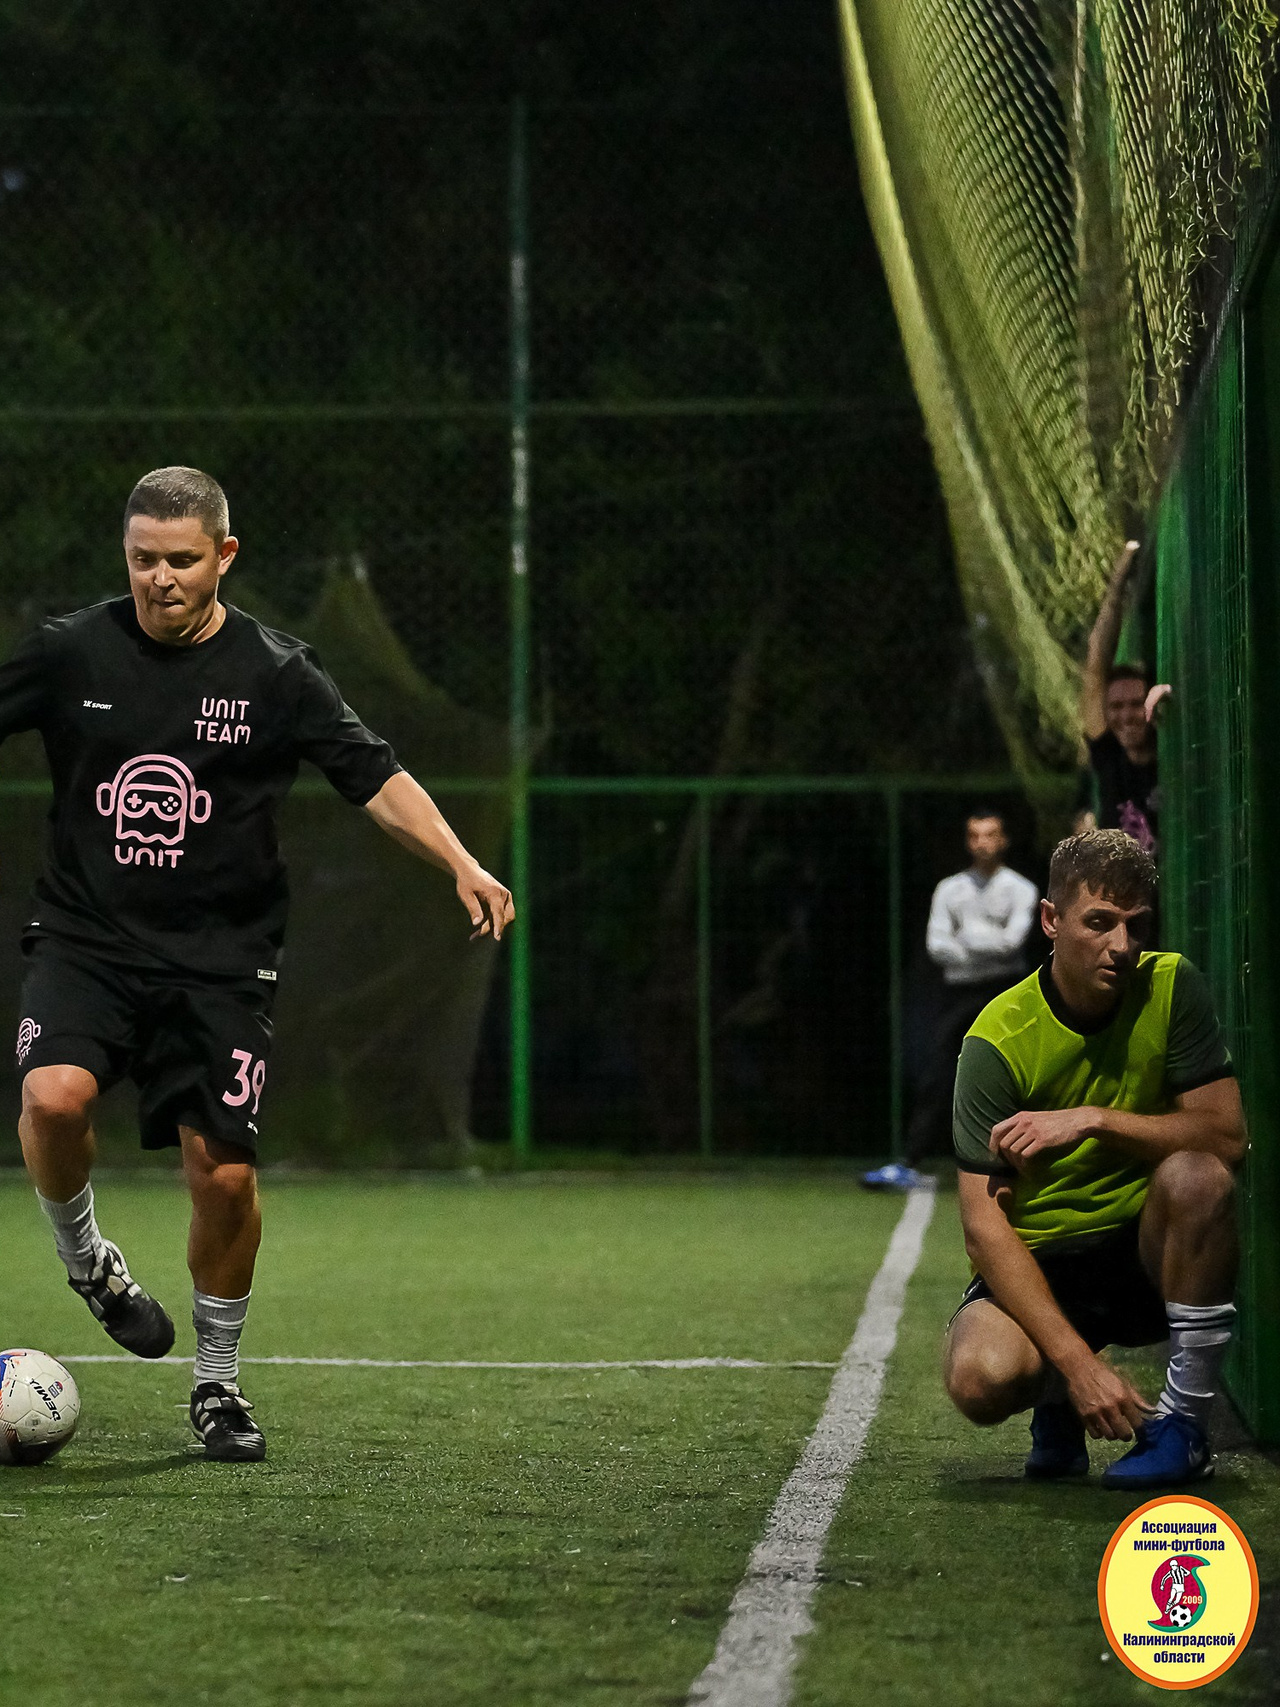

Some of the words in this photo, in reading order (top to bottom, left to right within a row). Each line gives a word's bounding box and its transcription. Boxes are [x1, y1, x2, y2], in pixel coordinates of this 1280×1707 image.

[91, 702, 113, 710] SPORT
[201, 697, 250, 721] UNIT
[193, 719, 251, 745] TEAM
[114, 844, 185, 869] UNIT
[221, 1048, 267, 1116] 39
